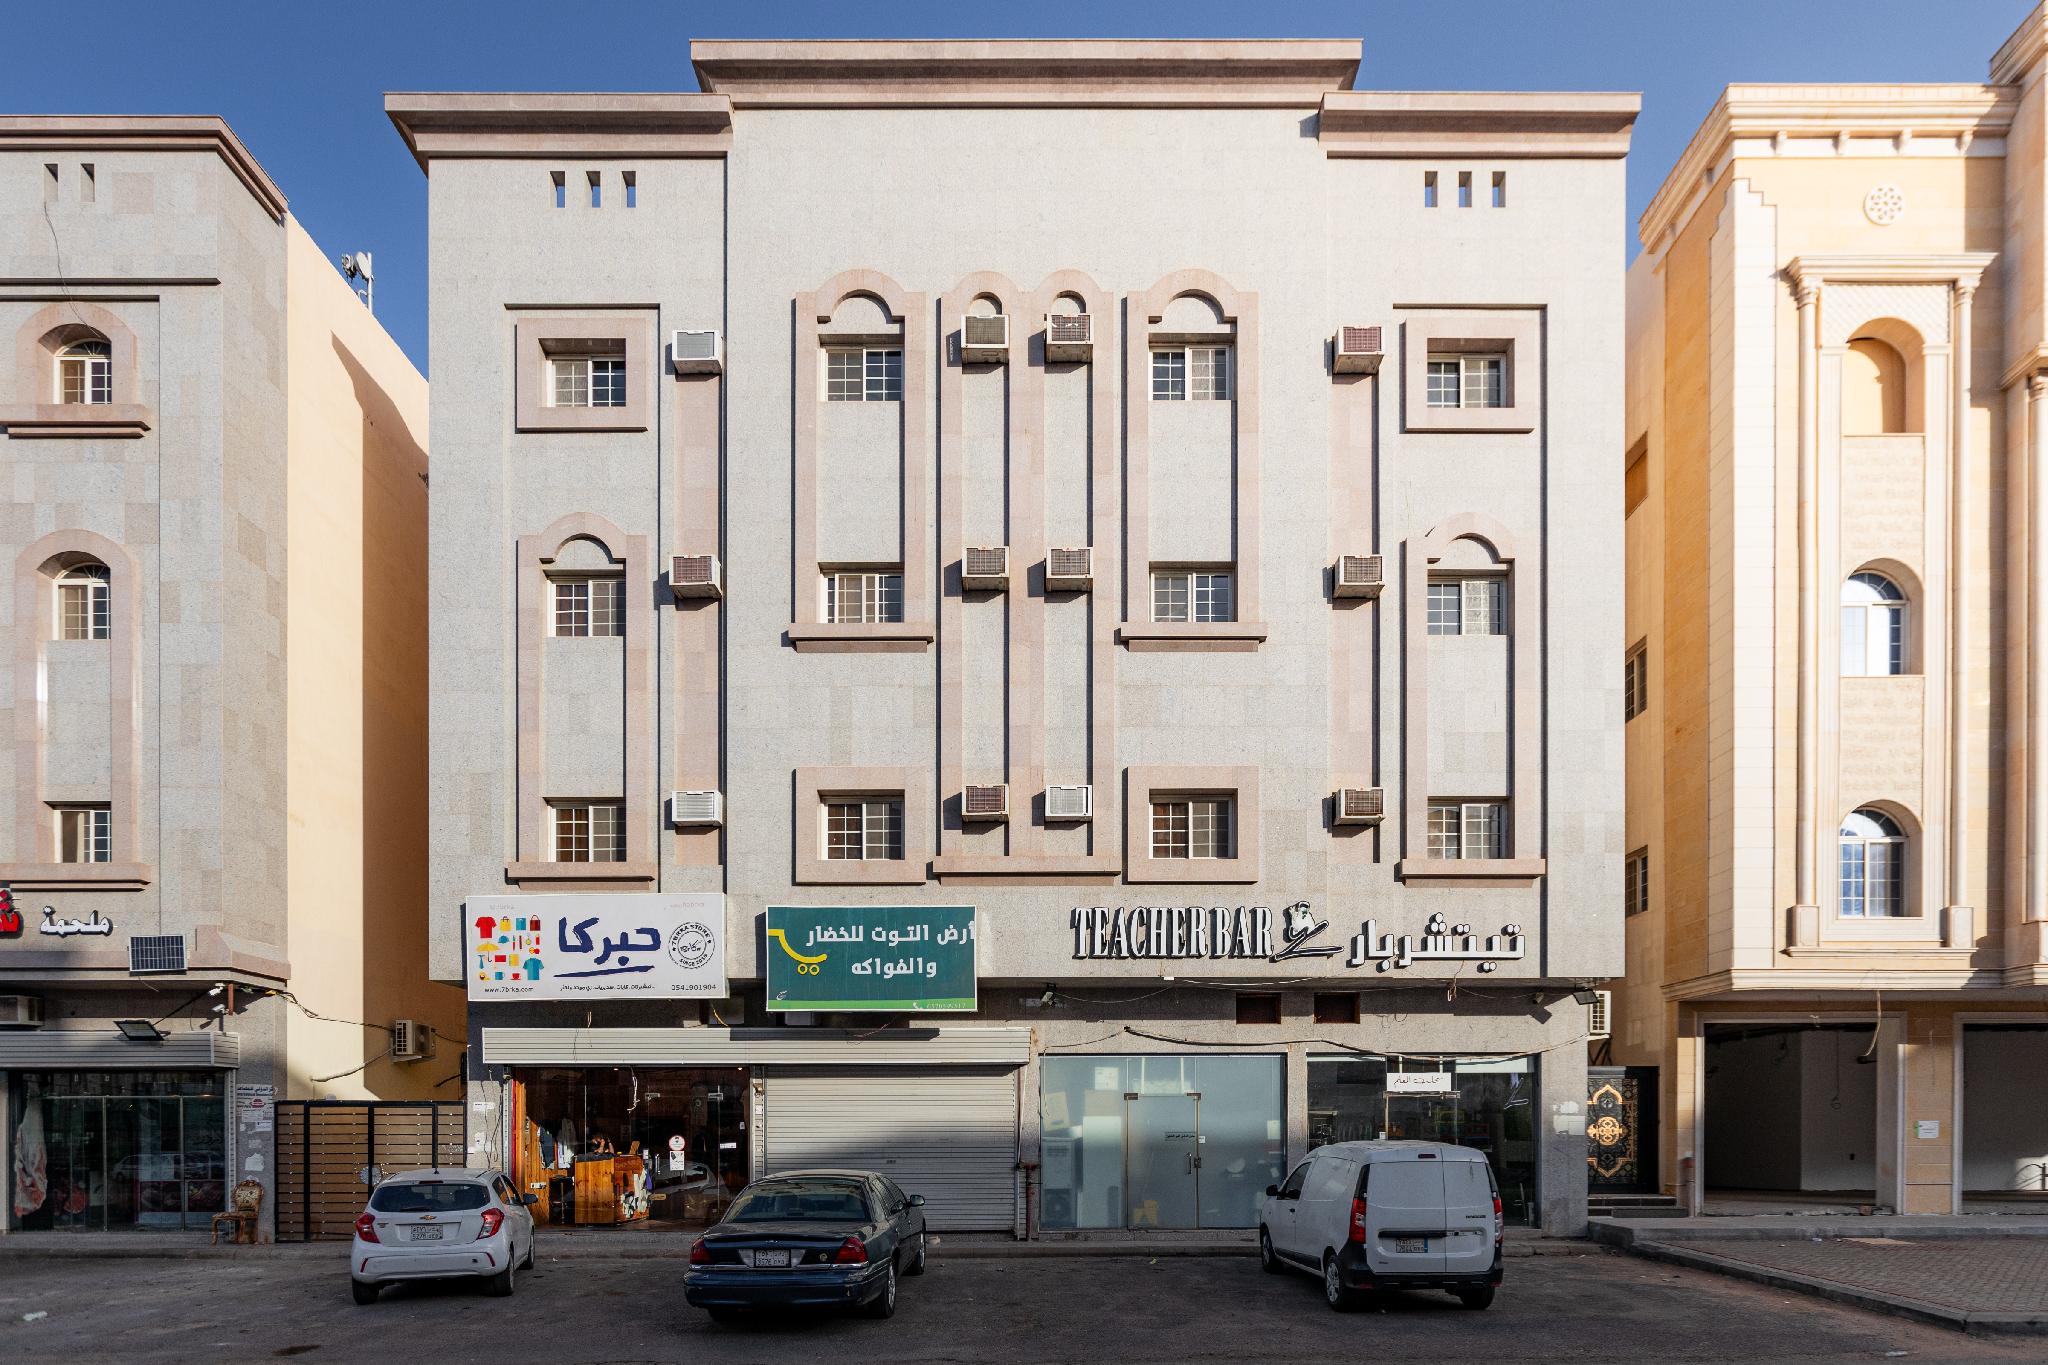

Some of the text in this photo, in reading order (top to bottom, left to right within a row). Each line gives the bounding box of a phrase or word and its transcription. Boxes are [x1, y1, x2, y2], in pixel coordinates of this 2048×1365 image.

[40, 905, 112, 937] ملحمة
[690, 925, 710, 938] STORE
[806, 920, 975, 947] أرض التوت للخضار
[559, 916, 661, 966] حبركا
[852, 957, 937, 979] والفواكه
